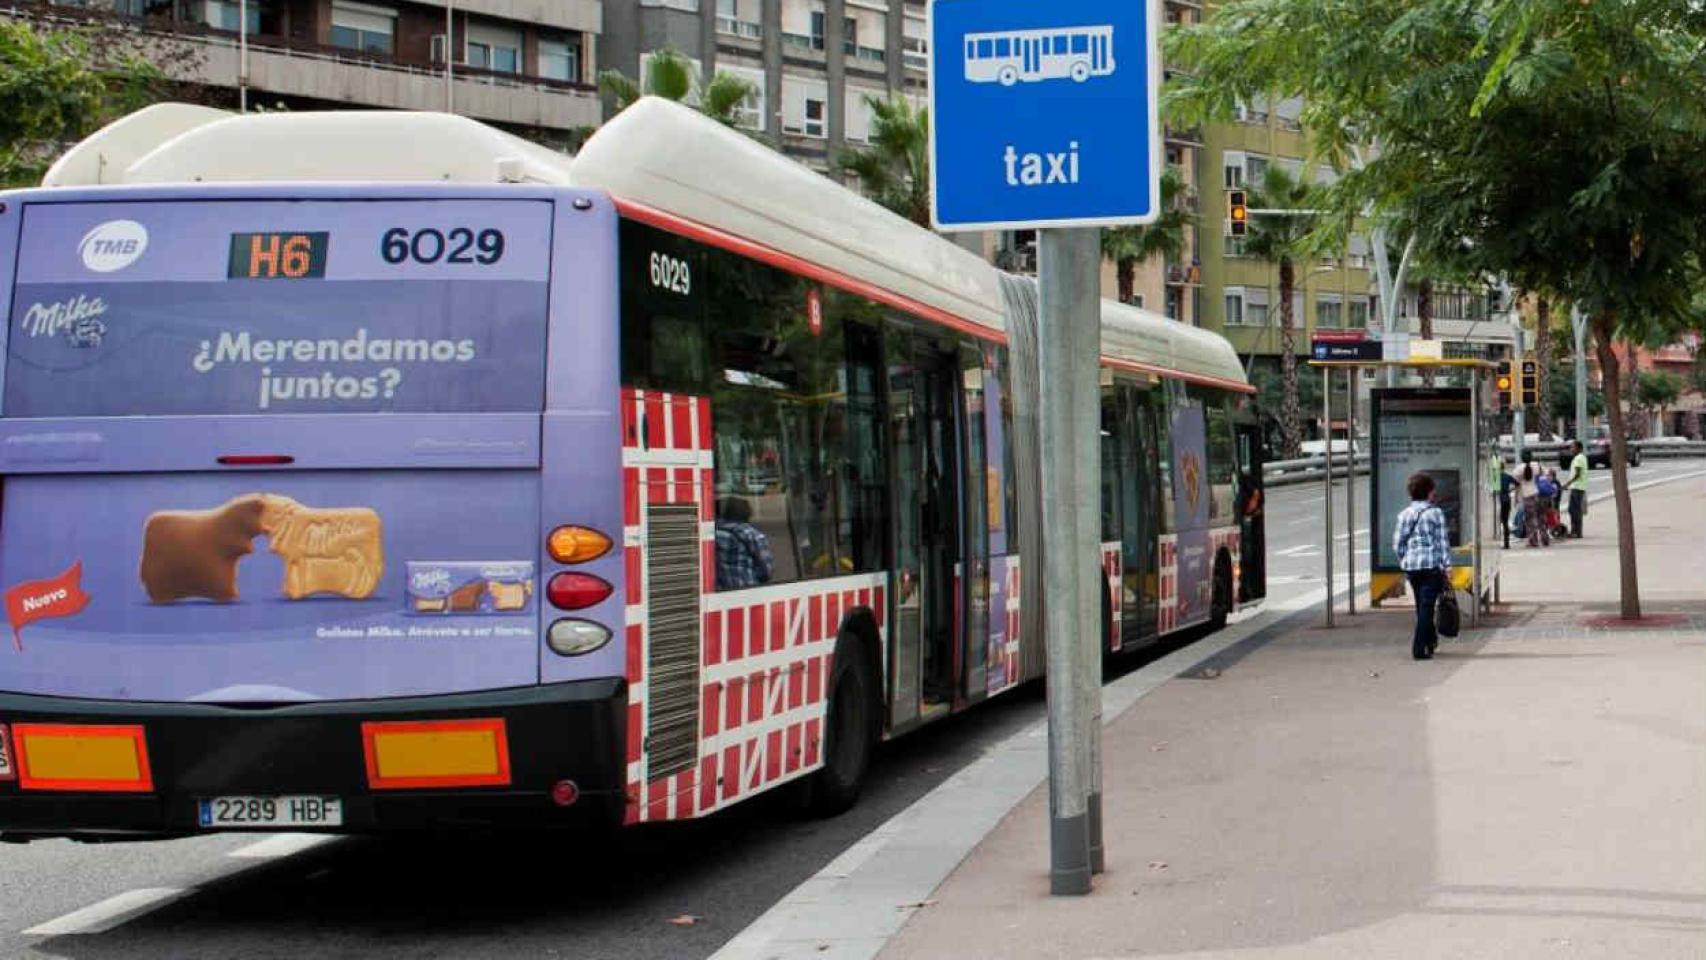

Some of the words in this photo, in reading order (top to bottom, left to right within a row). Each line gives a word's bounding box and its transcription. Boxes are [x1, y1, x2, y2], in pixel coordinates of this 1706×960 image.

[1003, 141, 1079, 185] taxi
[94, 239, 139, 257] TMB
[249, 234, 311, 278] H6
[380, 227, 505, 265] 6029
[648, 249, 692, 296] 6029
[21, 294, 108, 338] Milka
[193, 328, 475, 373] ¿Merendamos
[259, 367, 401, 409] juntos?
[23, 588, 68, 612] Nuevo
[216, 799, 276, 821] 2289
[291, 799, 339, 821] HBF
